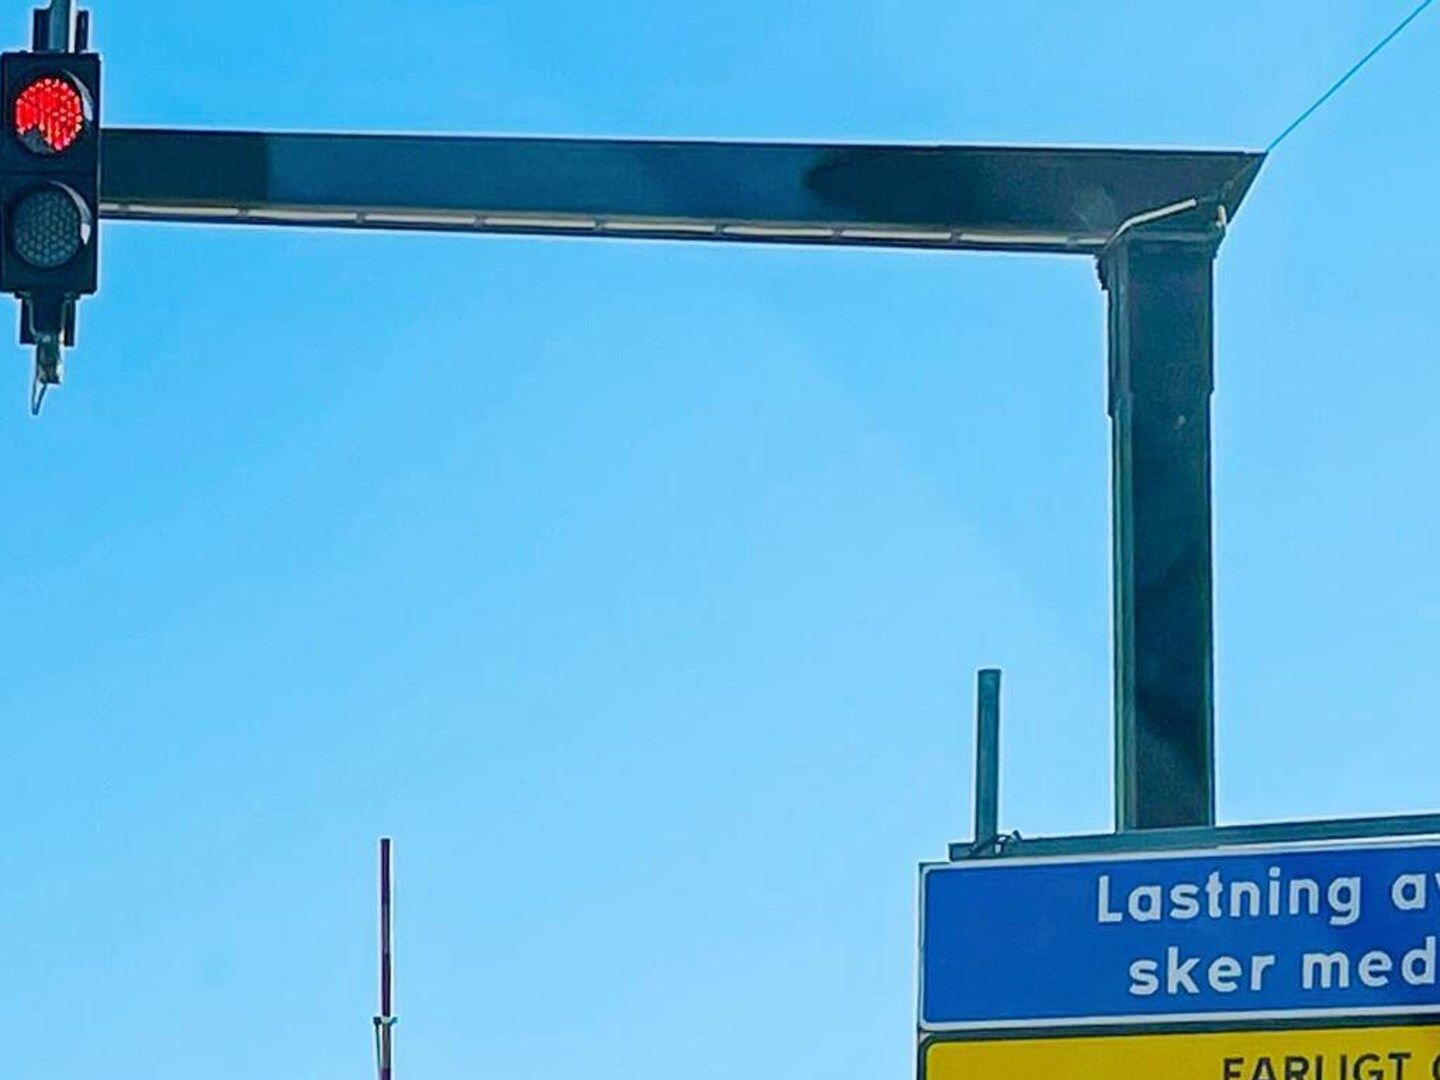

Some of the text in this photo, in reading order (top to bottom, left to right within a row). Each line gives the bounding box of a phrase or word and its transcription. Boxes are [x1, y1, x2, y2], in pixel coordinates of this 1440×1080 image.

[1098, 866, 1440, 926] Lastning a
[1128, 935, 1437, 996] sker med
